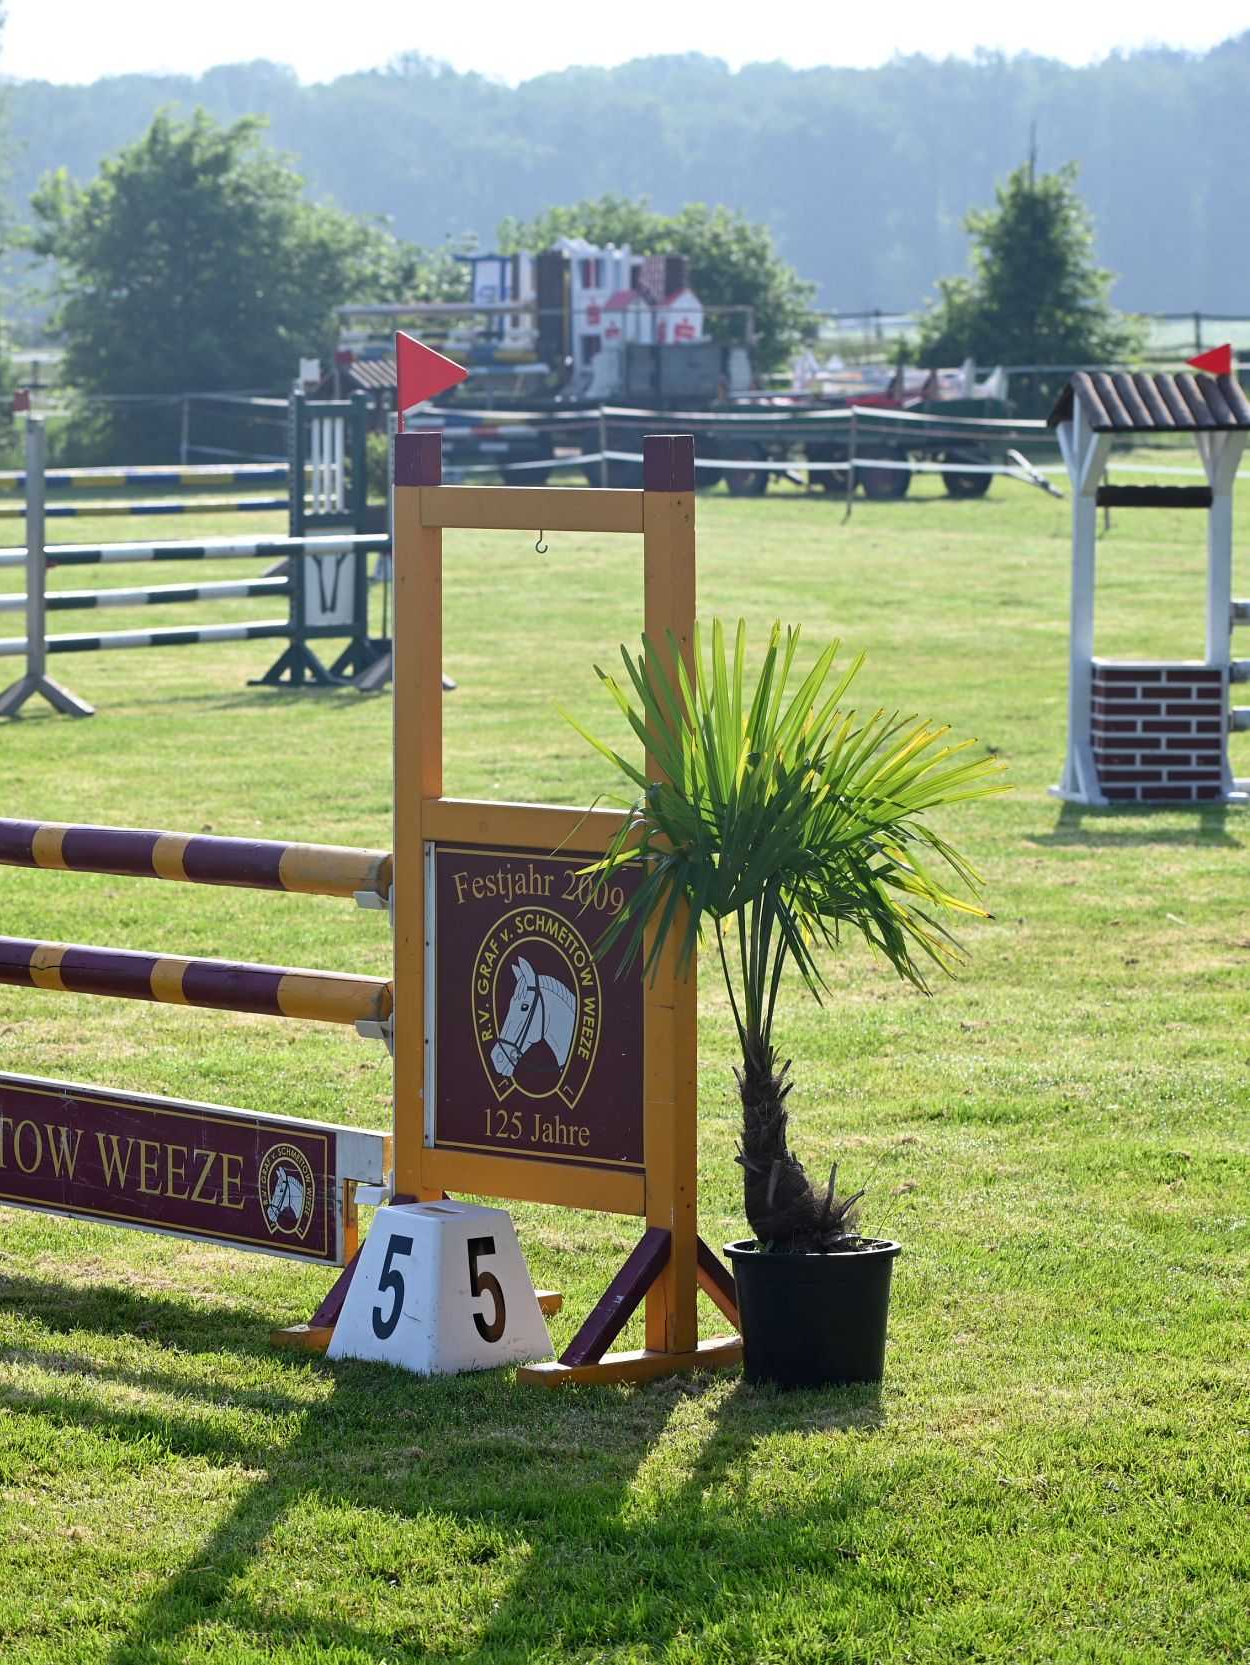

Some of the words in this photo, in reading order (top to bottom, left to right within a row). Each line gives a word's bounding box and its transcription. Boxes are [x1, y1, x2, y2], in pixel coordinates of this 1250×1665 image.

[453, 864, 554, 903] Festjahr
[561, 869, 624, 915] 2009
[477, 939, 500, 995] GRAF
[500, 928, 514, 942] v.
[515, 914, 594, 986] SCHMETTOW
[577, 997, 596, 1061] WEEZE
[95, 1132, 245, 1210] WEEZE
[484, 1107, 523, 1140] 125
[531, 1112, 591, 1147] Jahre
[372, 1233, 414, 1340] 5
[467, 1235, 506, 1343] 5
